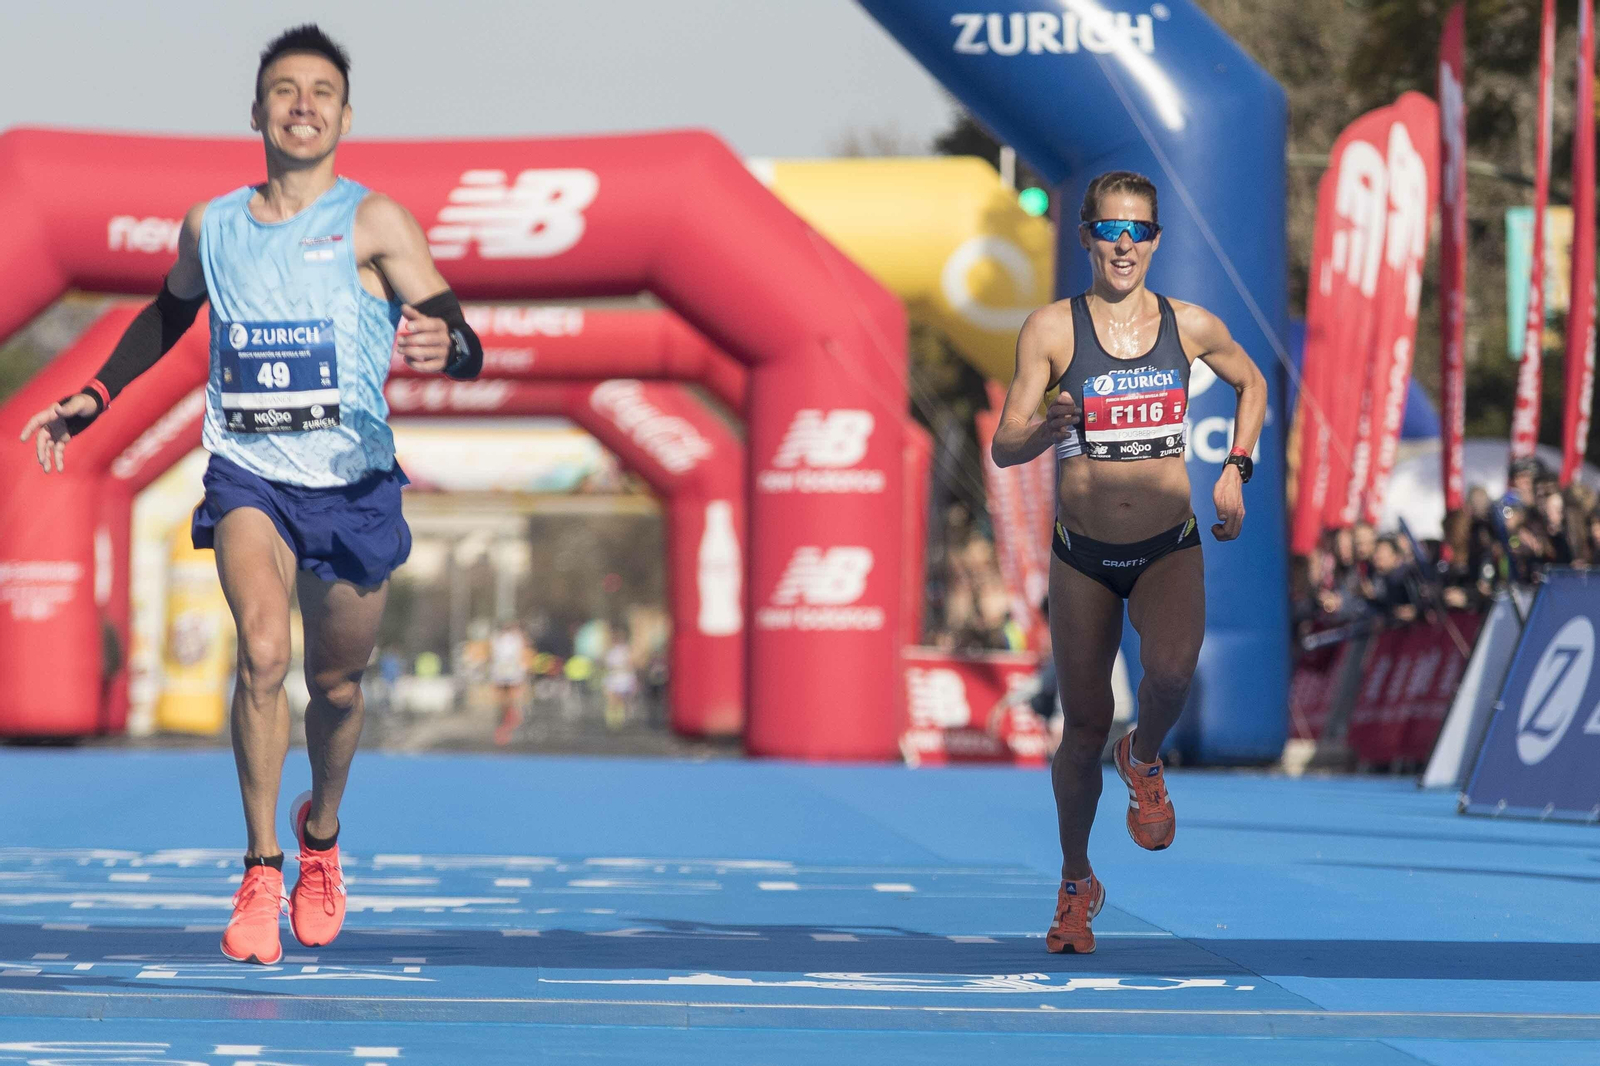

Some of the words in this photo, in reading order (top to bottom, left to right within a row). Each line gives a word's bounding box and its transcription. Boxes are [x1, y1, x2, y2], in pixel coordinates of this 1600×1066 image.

[951, 12, 1155, 56] ZURICH
[251, 326, 320, 345] ZURICH
[257, 361, 290, 389] 49
[1117, 373, 1174, 390] ZURICH
[1111, 402, 1163, 424] F116
[302, 417, 337, 431] ZURICH
[1160, 446, 1183, 457] ZURICH
[1102, 559, 1139, 568] CRAFT
